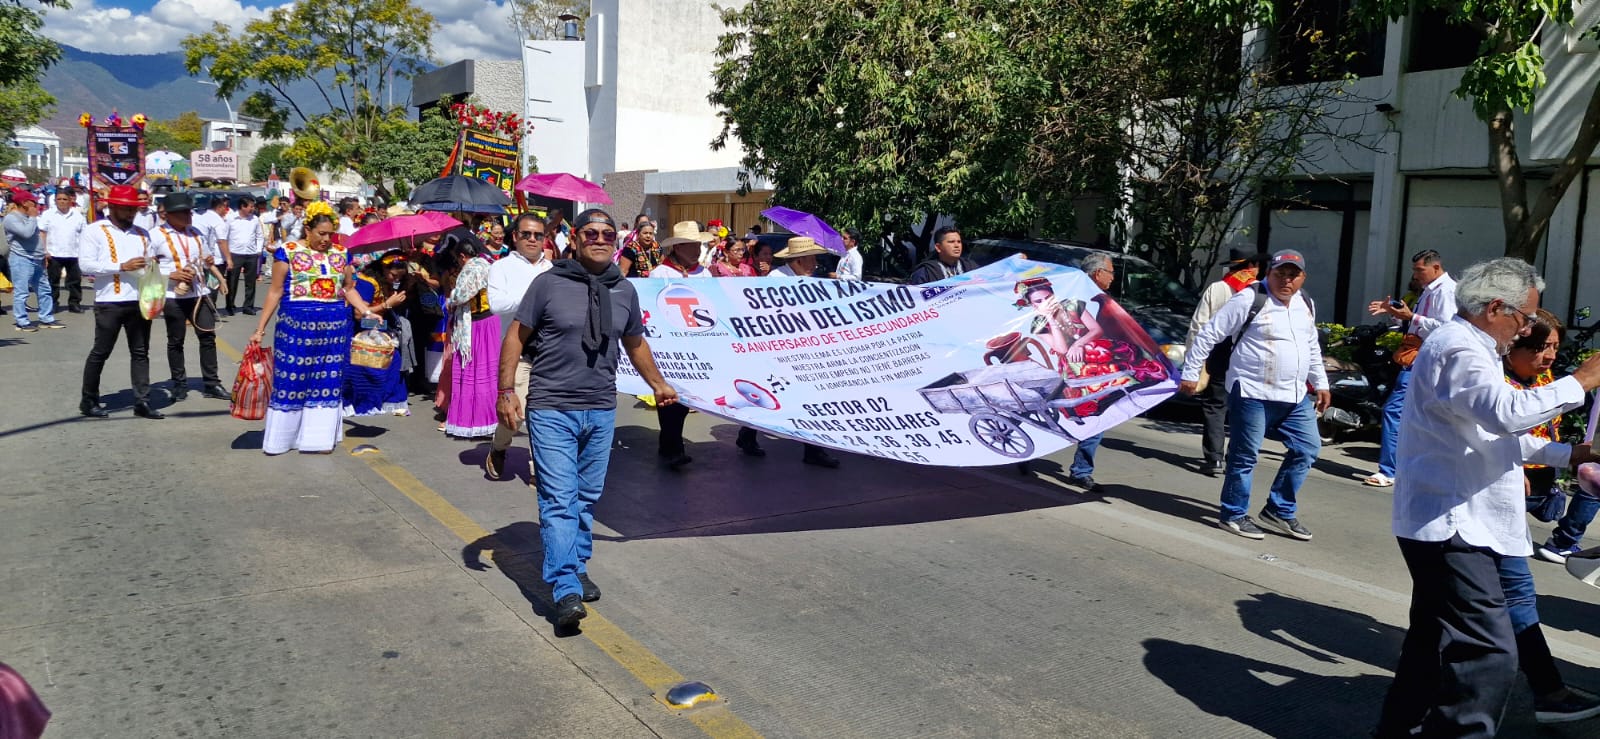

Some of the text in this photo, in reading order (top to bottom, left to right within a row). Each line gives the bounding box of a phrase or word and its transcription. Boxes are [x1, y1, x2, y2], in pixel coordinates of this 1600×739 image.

[198, 154, 211, 162] 58
[113, 172, 127, 180] 58
[743, 279, 832, 309] SECCIÓN
[729, 286, 916, 338] REGIÓN DEL ISTMO
[731, 308, 939, 353] 58 ANIVERSARIO DE TELESECUNDARIAS
[811, 350, 831, 360] LEMA
[832, 349, 843, 357] ES
[843, 343, 871, 355] LUCHAR
[871, 340, 886, 350] POR
[886, 338, 897, 346] LA
[897, 331, 923, 343] PATRIA
[672, 352, 686, 360] DE
[686, 352, 699, 361] LA
[792, 362, 825, 371] NUESTRA
[826, 359, 848, 368] ARMA
[848, 357, 859, 365] LA
[687, 362, 695, 371] Y
[695, 362, 714, 371] LOS
[795, 372, 830, 382] NUESTRO
[860, 365, 871, 374] NO
[872, 361, 893, 372] TIENE
[892, 351, 931, 368] BARRERAS
[663, 371, 710, 380] ABORALES
[870, 376, 881, 384] AL
[881, 374, 894, 383] FIN
[802, 397, 893, 417] SECTOR 02
[787, 411, 940, 432] ZONAS ESCOLARES
